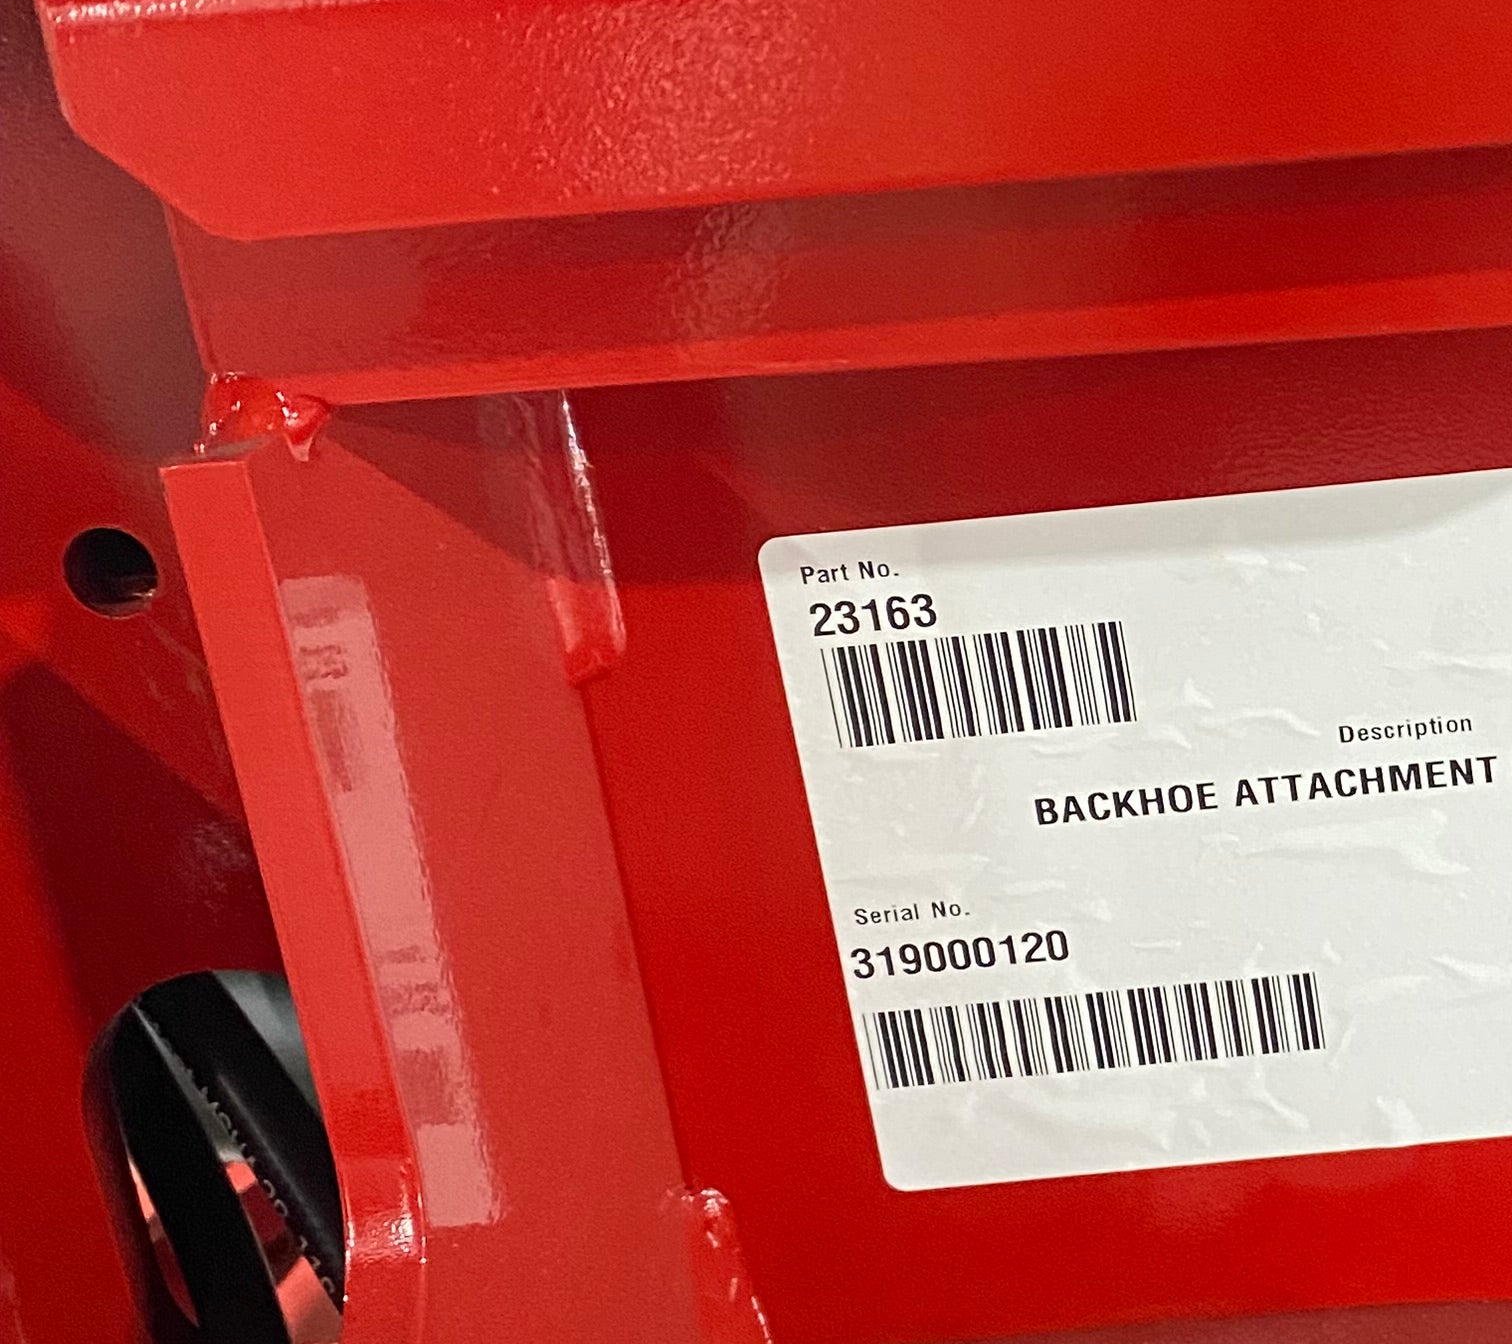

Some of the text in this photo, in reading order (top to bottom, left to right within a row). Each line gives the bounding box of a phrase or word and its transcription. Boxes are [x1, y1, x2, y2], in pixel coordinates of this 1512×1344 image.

[798, 559, 900, 586] Part No.
[808, 592, 938, 638] 23163
[1337, 717, 1473, 744] Description
[1033, 781, 1220, 827] BACKHOE
[1234, 754, 1498, 808] ATTACHMENT
[853, 900, 971, 927] Serial No.
[850, 929, 1070, 980] 319000120
